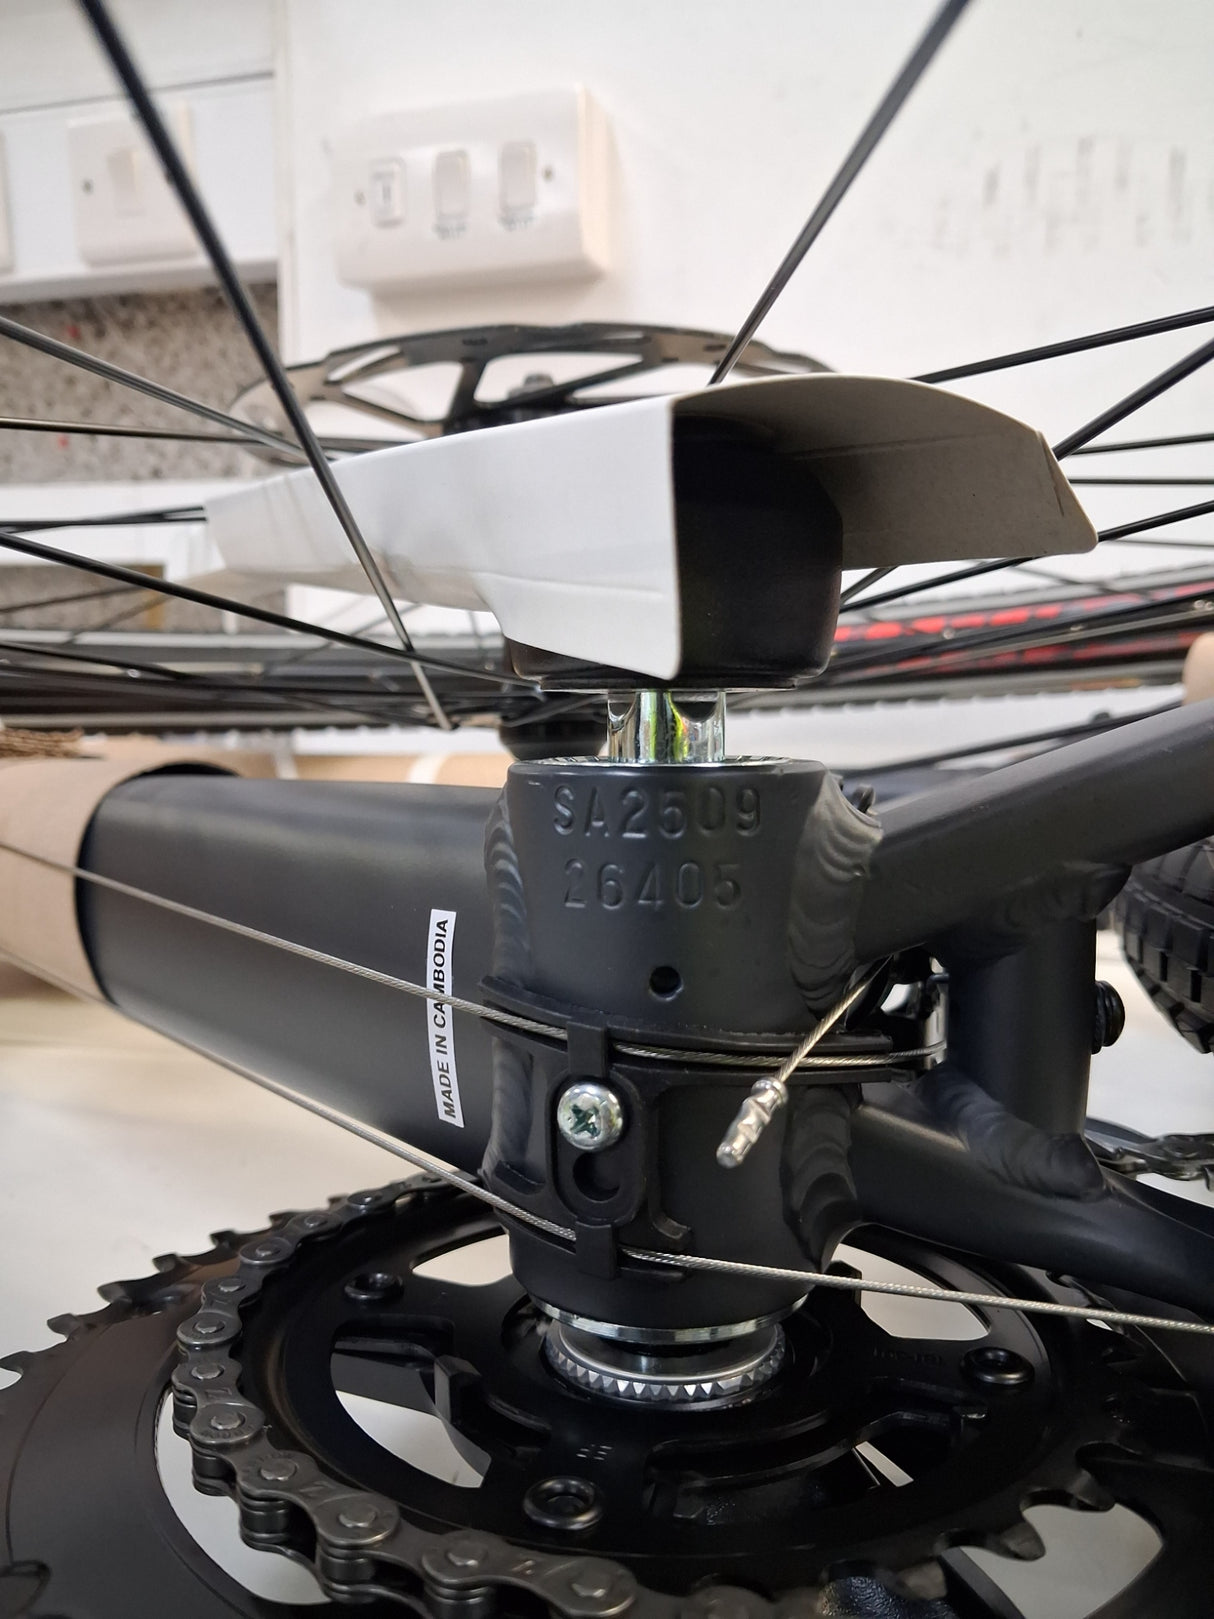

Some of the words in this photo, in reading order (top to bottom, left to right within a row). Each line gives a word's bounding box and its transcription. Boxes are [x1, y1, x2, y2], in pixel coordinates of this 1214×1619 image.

[552, 784, 762, 839] SA2509
[563, 857, 743, 911] 26405
[435, 1034, 448, 1055] IN
[437, 1060, 457, 1119] MADE
